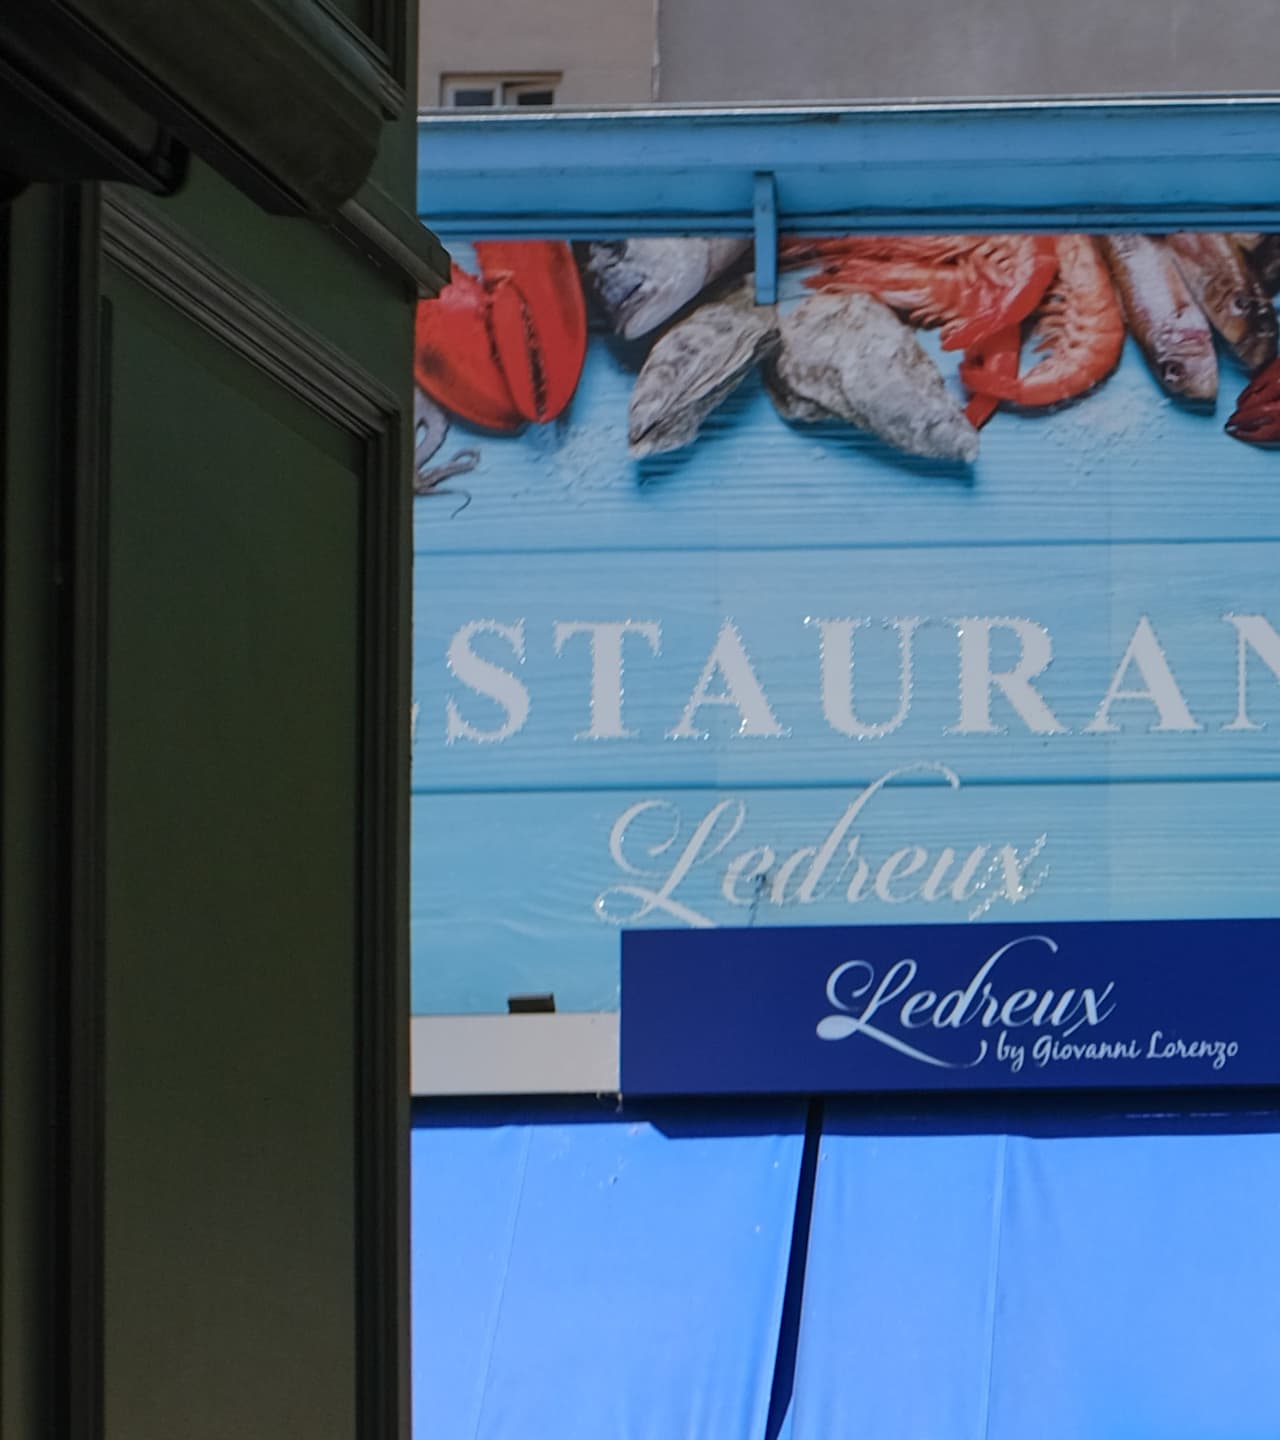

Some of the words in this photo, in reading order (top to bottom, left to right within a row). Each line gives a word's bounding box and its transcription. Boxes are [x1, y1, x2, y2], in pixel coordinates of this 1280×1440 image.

[594, 761, 1050, 928] Ledreux
[816, 935, 1116, 1068] Ledreux
[997, 1030, 1025, 1072] by
[1032, 1032, 1142, 1068] Giovanni
[1146, 1031, 1239, 1069] Lorenzo
